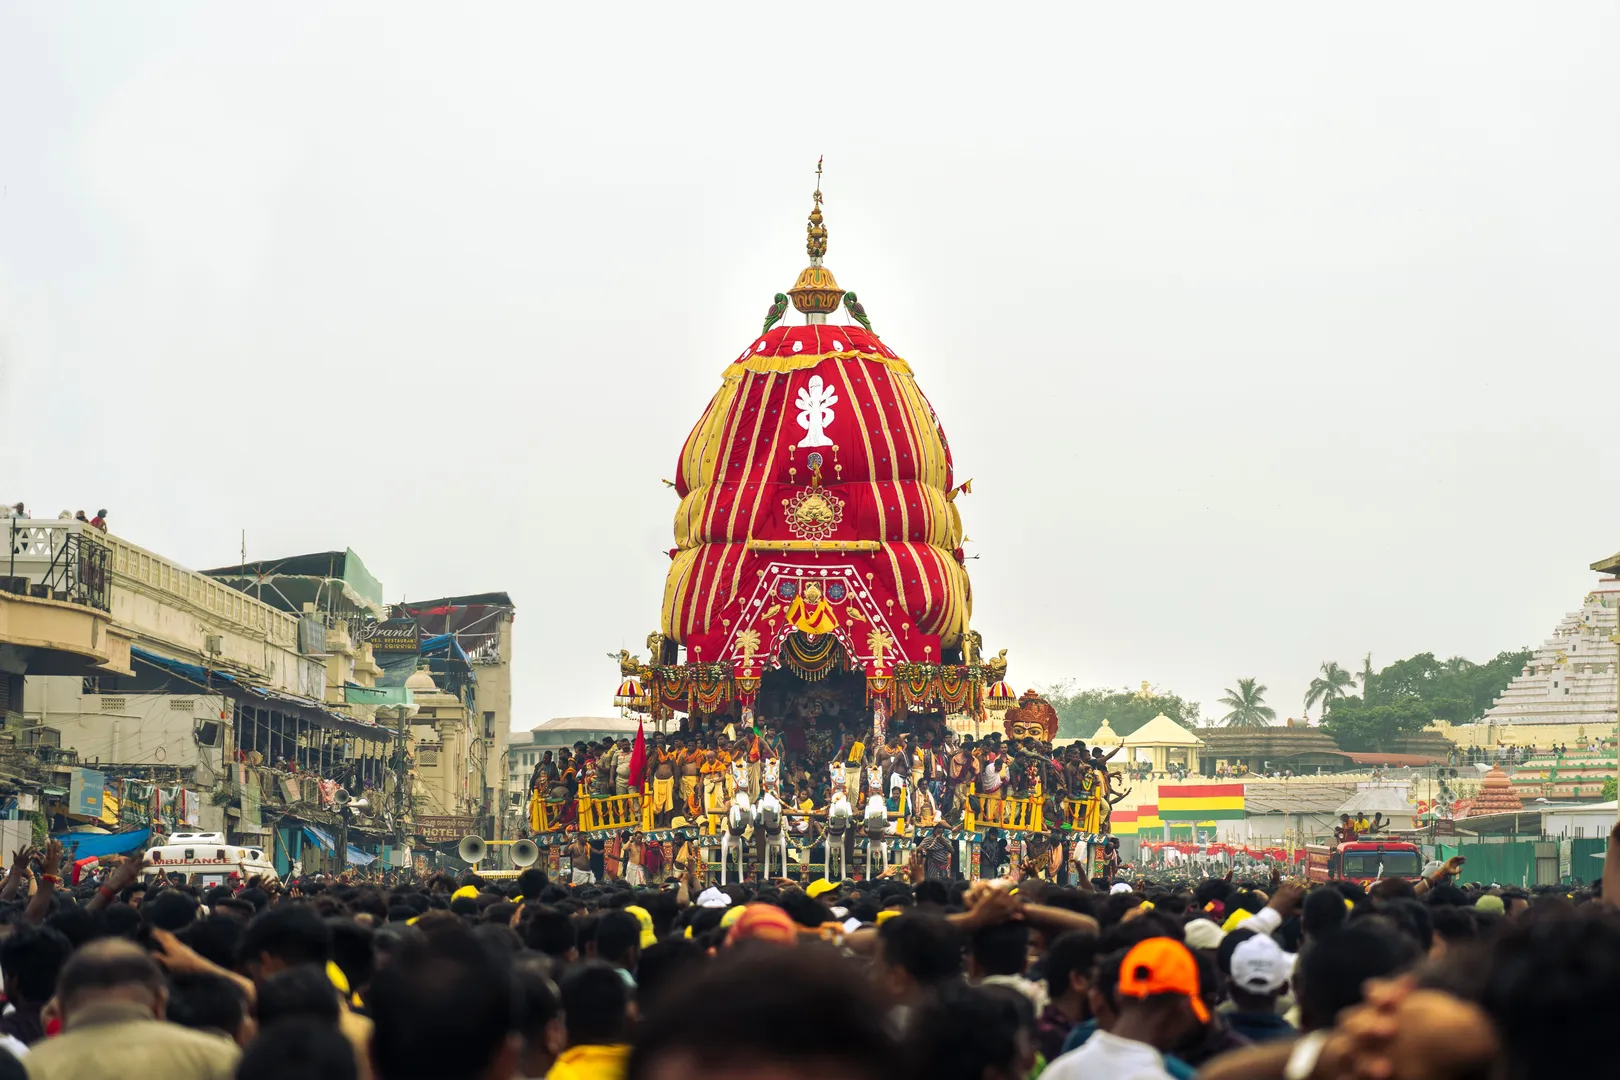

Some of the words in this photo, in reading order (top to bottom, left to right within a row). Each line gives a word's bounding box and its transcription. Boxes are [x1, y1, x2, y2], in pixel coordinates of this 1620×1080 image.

[356, 621, 417, 640] Grand
[423, 828, 460, 837] HOTEL
[150, 857, 231, 865] MBULANCE
